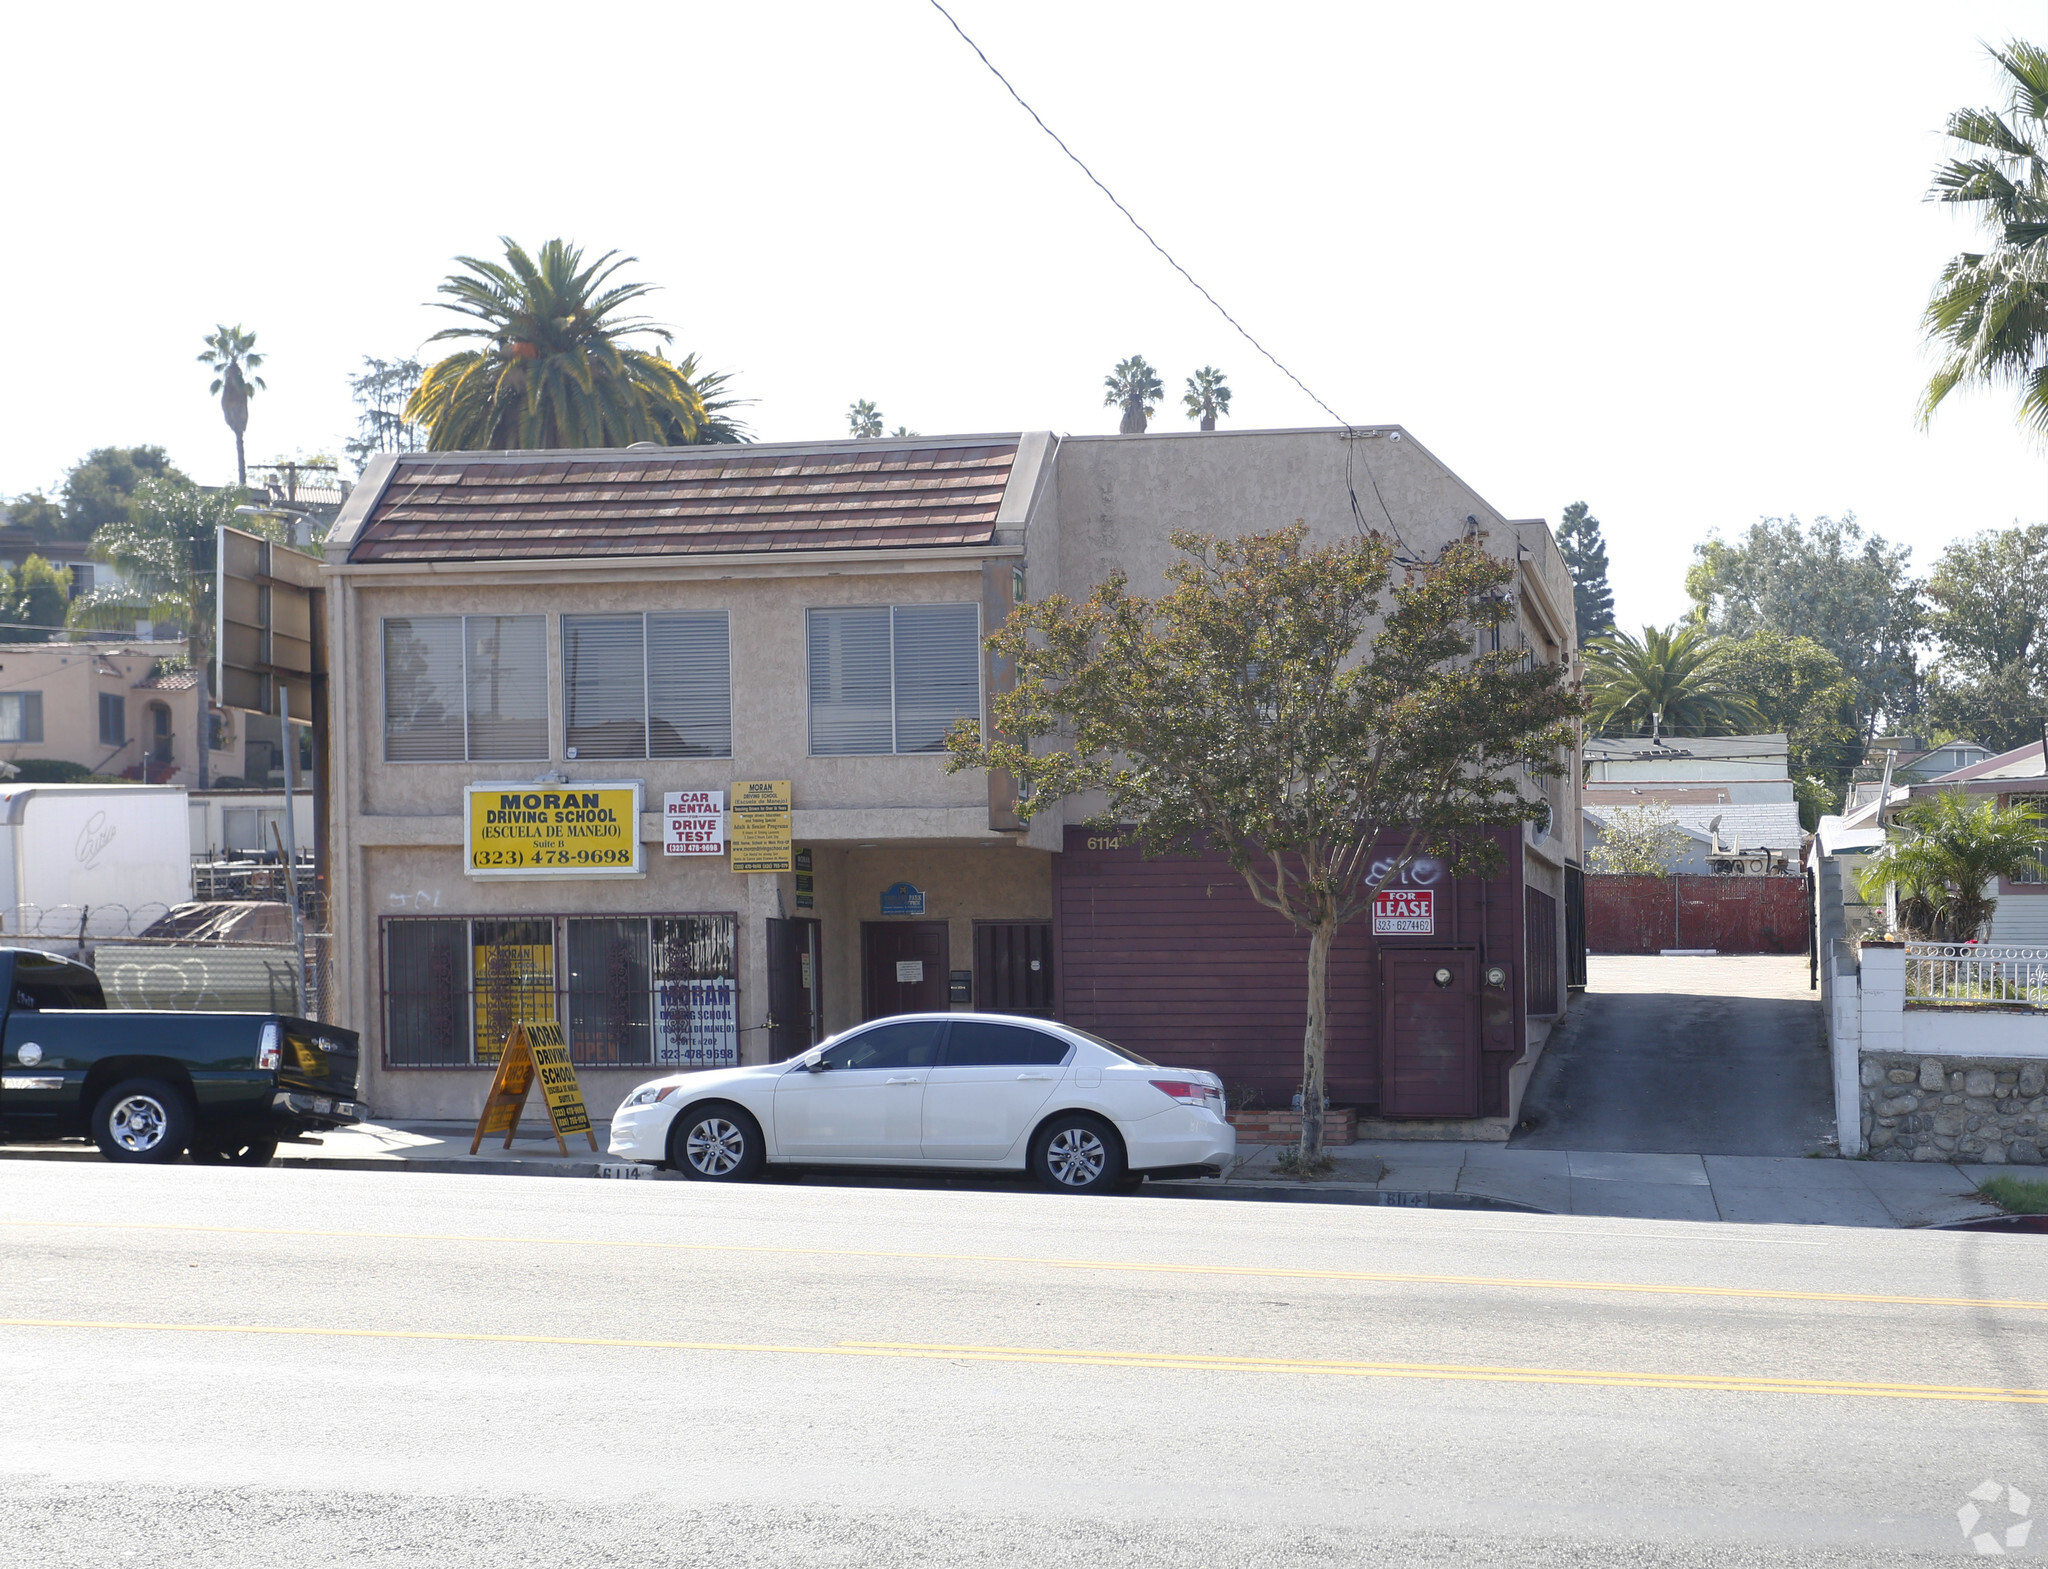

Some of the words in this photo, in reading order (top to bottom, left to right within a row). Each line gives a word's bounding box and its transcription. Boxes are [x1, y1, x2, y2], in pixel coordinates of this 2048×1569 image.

[500, 794, 599, 809] MORAN
[681, 793, 709, 802] CAR
[669, 804, 720, 813] RENTAL
[487, 810, 547, 824] DRIVING
[555, 809, 616, 823] SCHOOL
[482, 826, 542, 840] (ESCUELA
[546, 825, 563, 837] DE
[567, 824, 621, 838] MANEJO)
[672, 820, 716, 830] DRIVE
[676, 832, 712, 841] TEST
[1087, 836, 1120, 850] 6114
[473, 850, 524, 867] (323)
[531, 849, 630, 864] 478-9698
[1376, 901, 1430, 916] LEASE
[527, 1025, 565, 1047] MORAN
[536, 1048, 569, 1065] DRIVING
[576, 1042, 617, 1060] OPEN
[661, 1049, 733, 1059] 323-478-9698
[542, 1067, 576, 1085] SCHOOL
[603, 1167, 640, 1179] 6114
